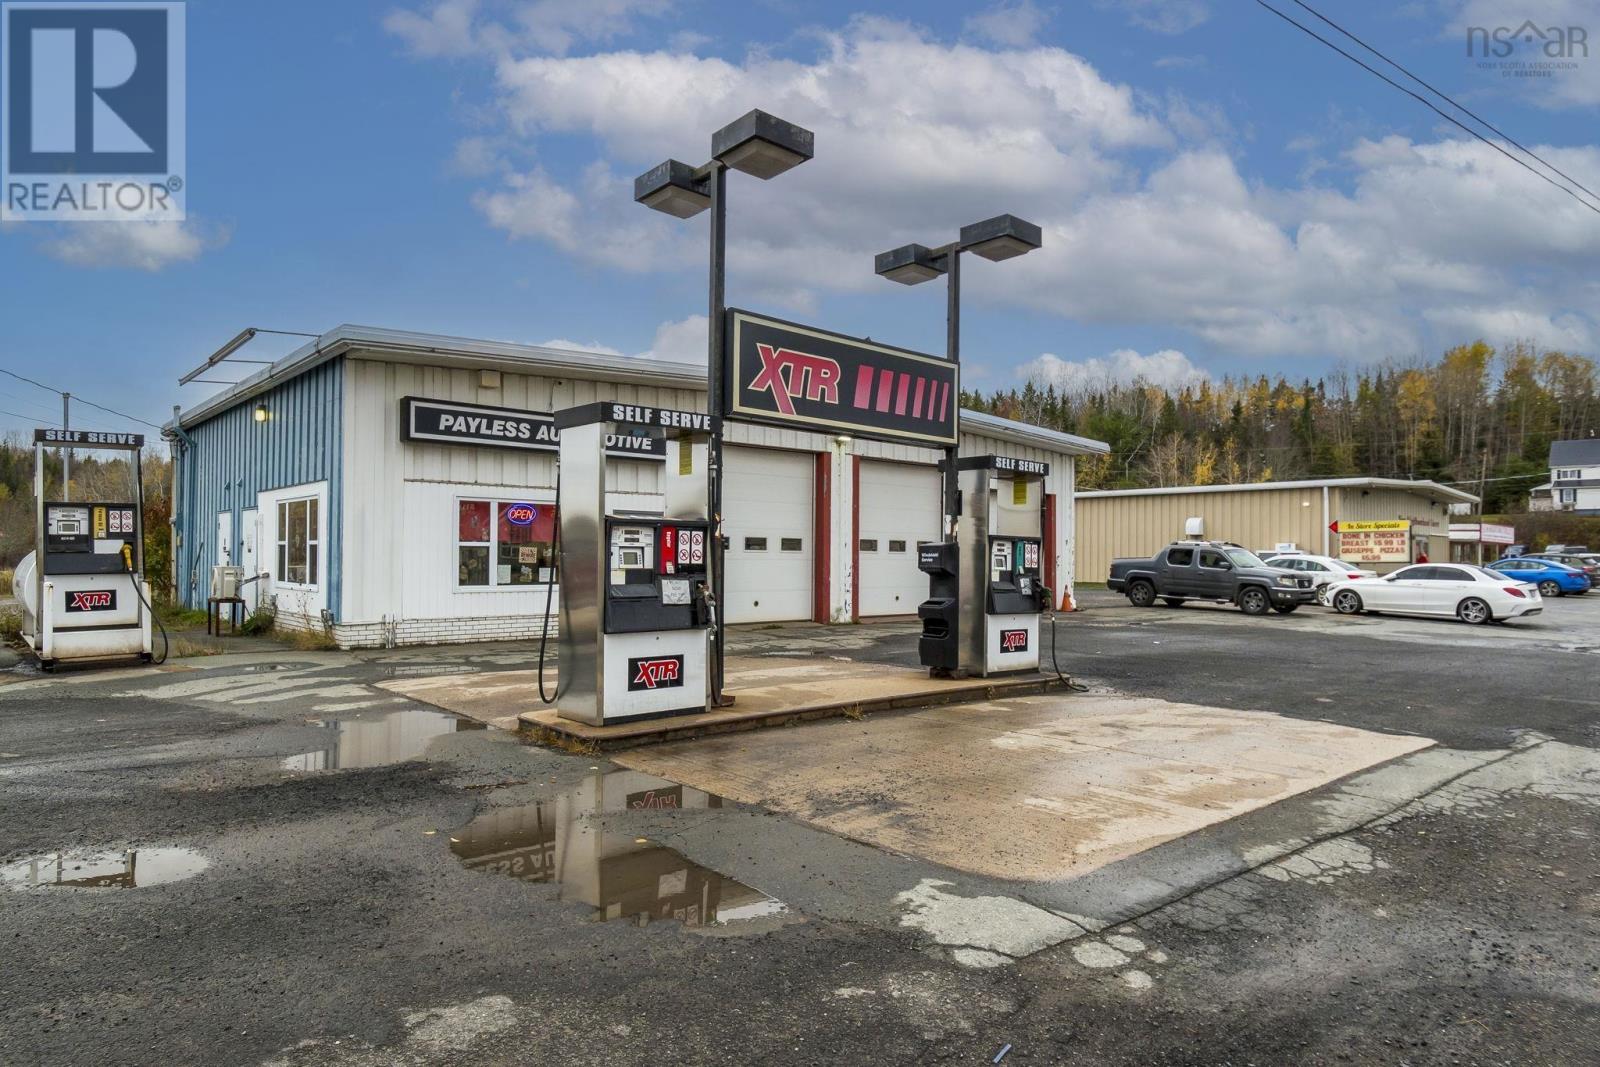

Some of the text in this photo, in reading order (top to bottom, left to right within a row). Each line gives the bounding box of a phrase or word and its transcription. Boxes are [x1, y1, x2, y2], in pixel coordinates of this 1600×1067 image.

[748, 342, 841, 416] XTR
[439, 414, 531, 439] PAYLESS
[613, 404, 711, 431] SELF SERVE
[45, 430, 135, 445] SELF SERVE
[995, 457, 1045, 474] SELF SERVE
[509, 509, 534, 520] OPEN
[1374, 522, 1401, 531] Specials
[70, 591, 111, 611] XTR
[1003, 631, 1027, 652] XTR
[633, 658, 680, 689] XTR
